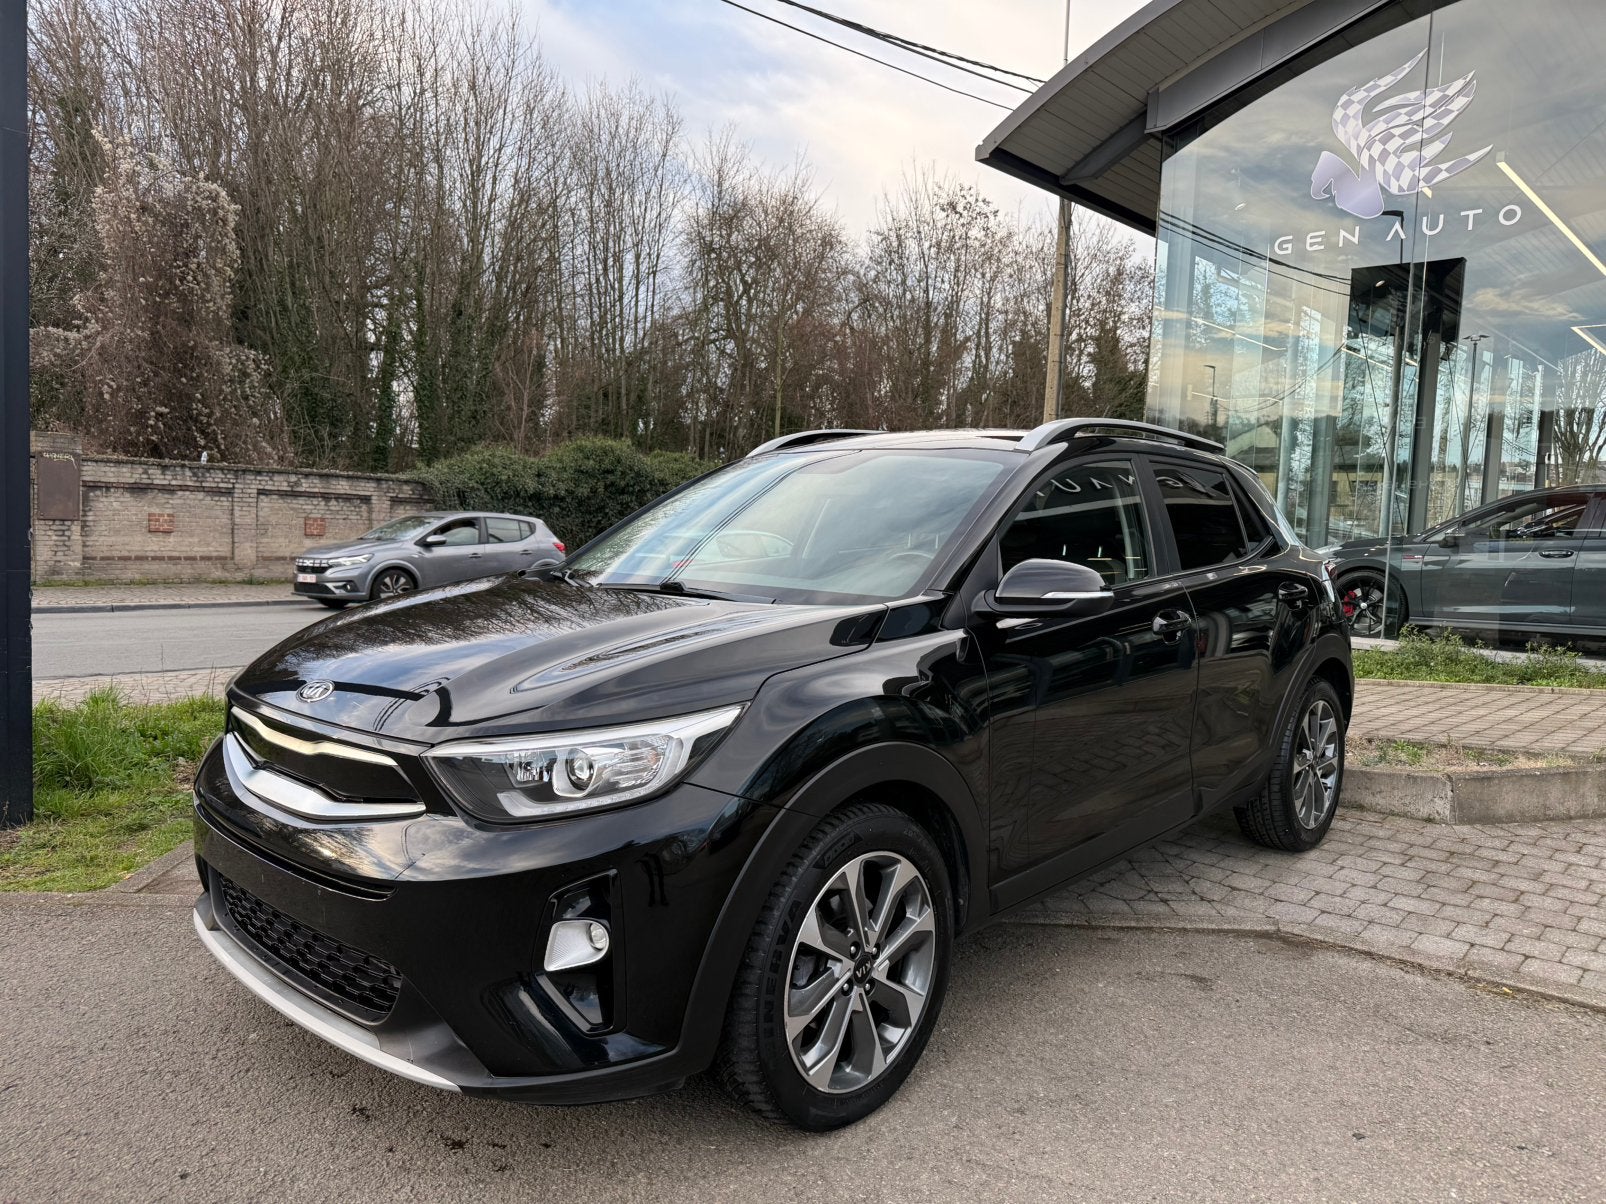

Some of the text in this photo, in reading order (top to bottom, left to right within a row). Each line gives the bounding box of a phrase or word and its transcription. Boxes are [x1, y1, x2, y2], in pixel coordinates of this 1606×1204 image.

[1274, 204, 1522, 255] GEN AUTO
[855, 960, 871, 978] KIA
